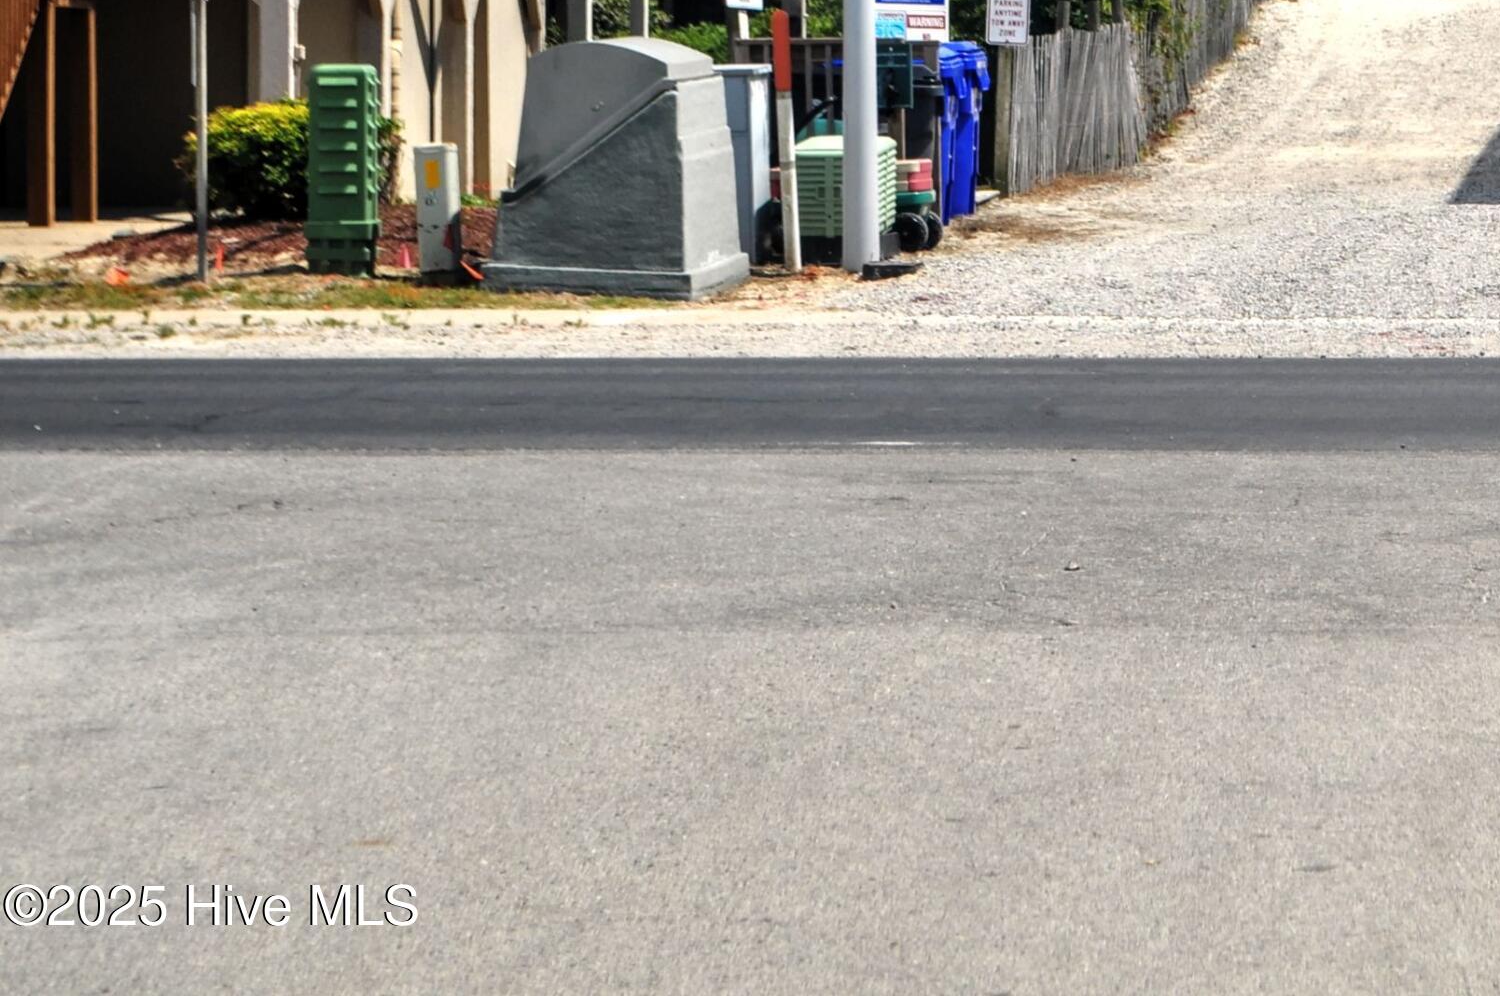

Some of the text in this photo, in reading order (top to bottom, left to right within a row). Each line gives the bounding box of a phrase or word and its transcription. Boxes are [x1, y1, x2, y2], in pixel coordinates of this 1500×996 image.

[995, 9, 1022, 17] ANYTIME
[909, 16, 944, 28] WARNING
[992, 18, 1024, 28] TOW AWAY
[999, 28, 1016, 37] ZONE
